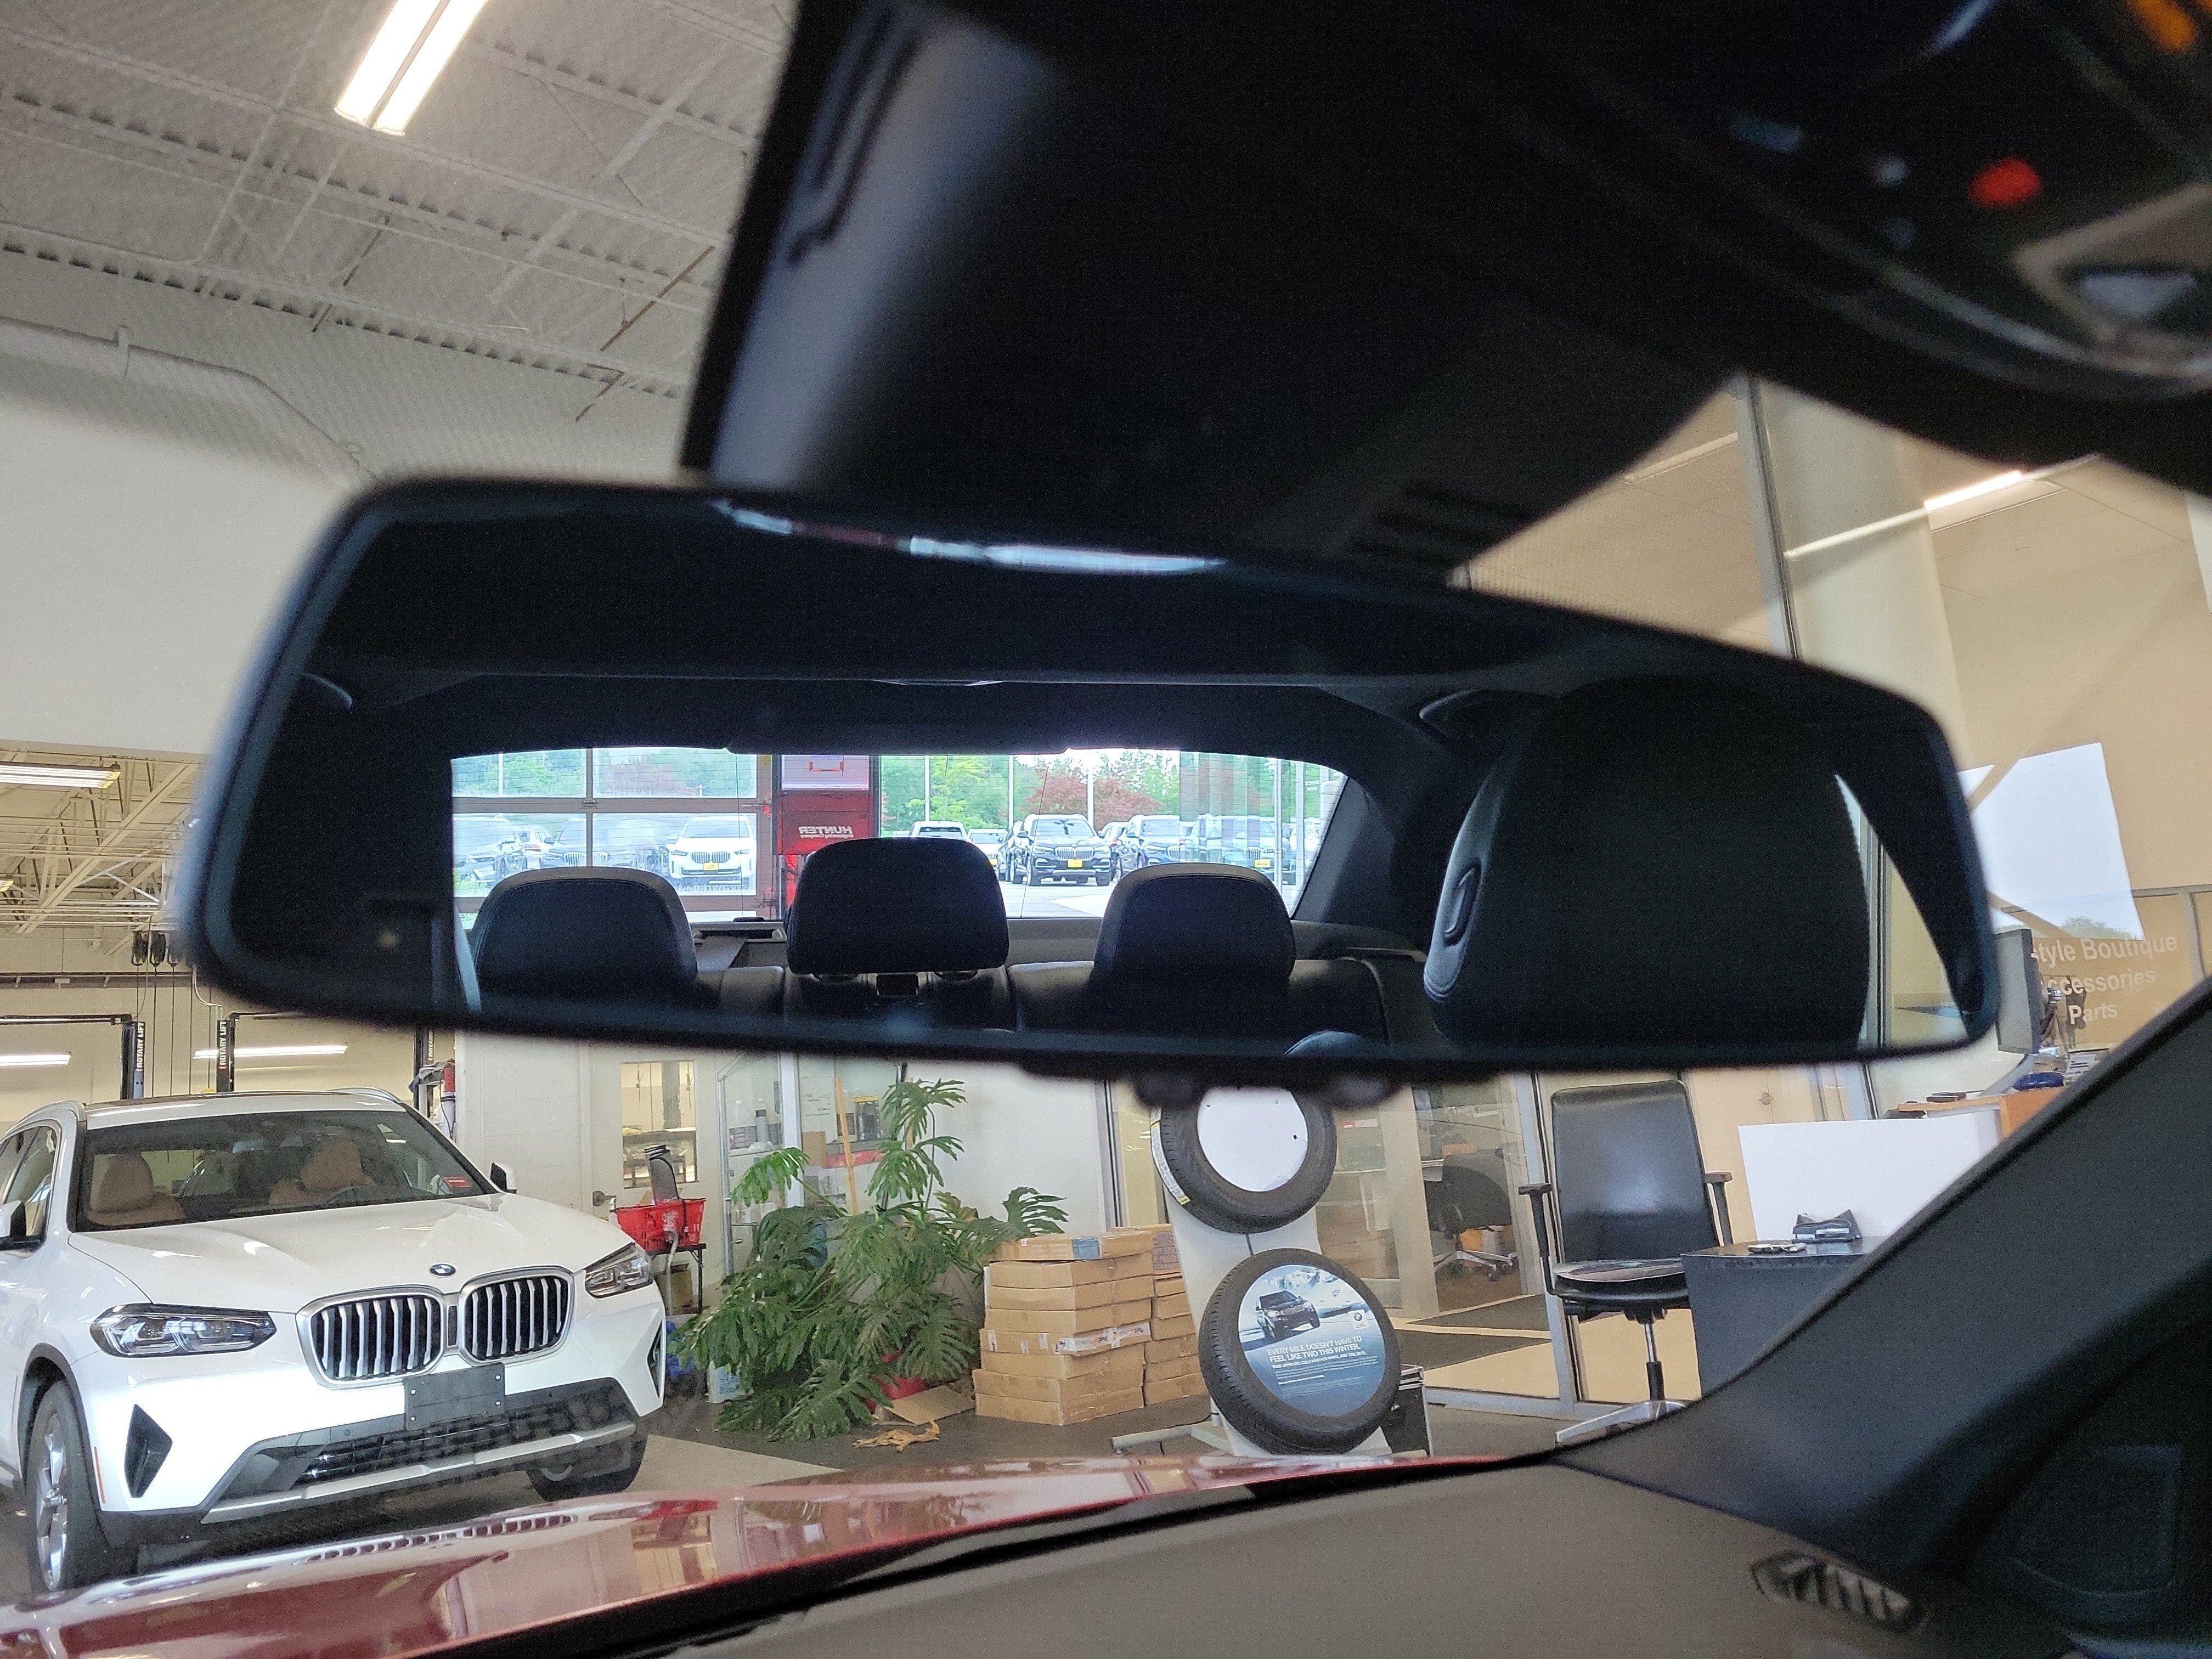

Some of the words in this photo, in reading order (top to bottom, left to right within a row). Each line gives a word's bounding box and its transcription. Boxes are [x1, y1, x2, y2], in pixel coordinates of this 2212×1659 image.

[2080, 936, 2177, 960] Boutique
[2040, 968, 2155, 995] ccessories
[2068, 1003, 2118, 1025] Parts
[1267, 1346, 1288, 1356] EVERY
[1289, 1345, 1306, 1353] MILE
[1306, 1341, 1334, 1350] DOESN'T
[1335, 1338, 1352, 1346] HAVE
[1269, 1355, 1287, 1363] FEEL
[1286, 1352, 1302, 1361] LIKE
[1302, 1350, 1318, 1358] TWO
[1318, 1347, 1334, 1356] THIS
[1334, 1343, 1361, 1353] WINTER.
